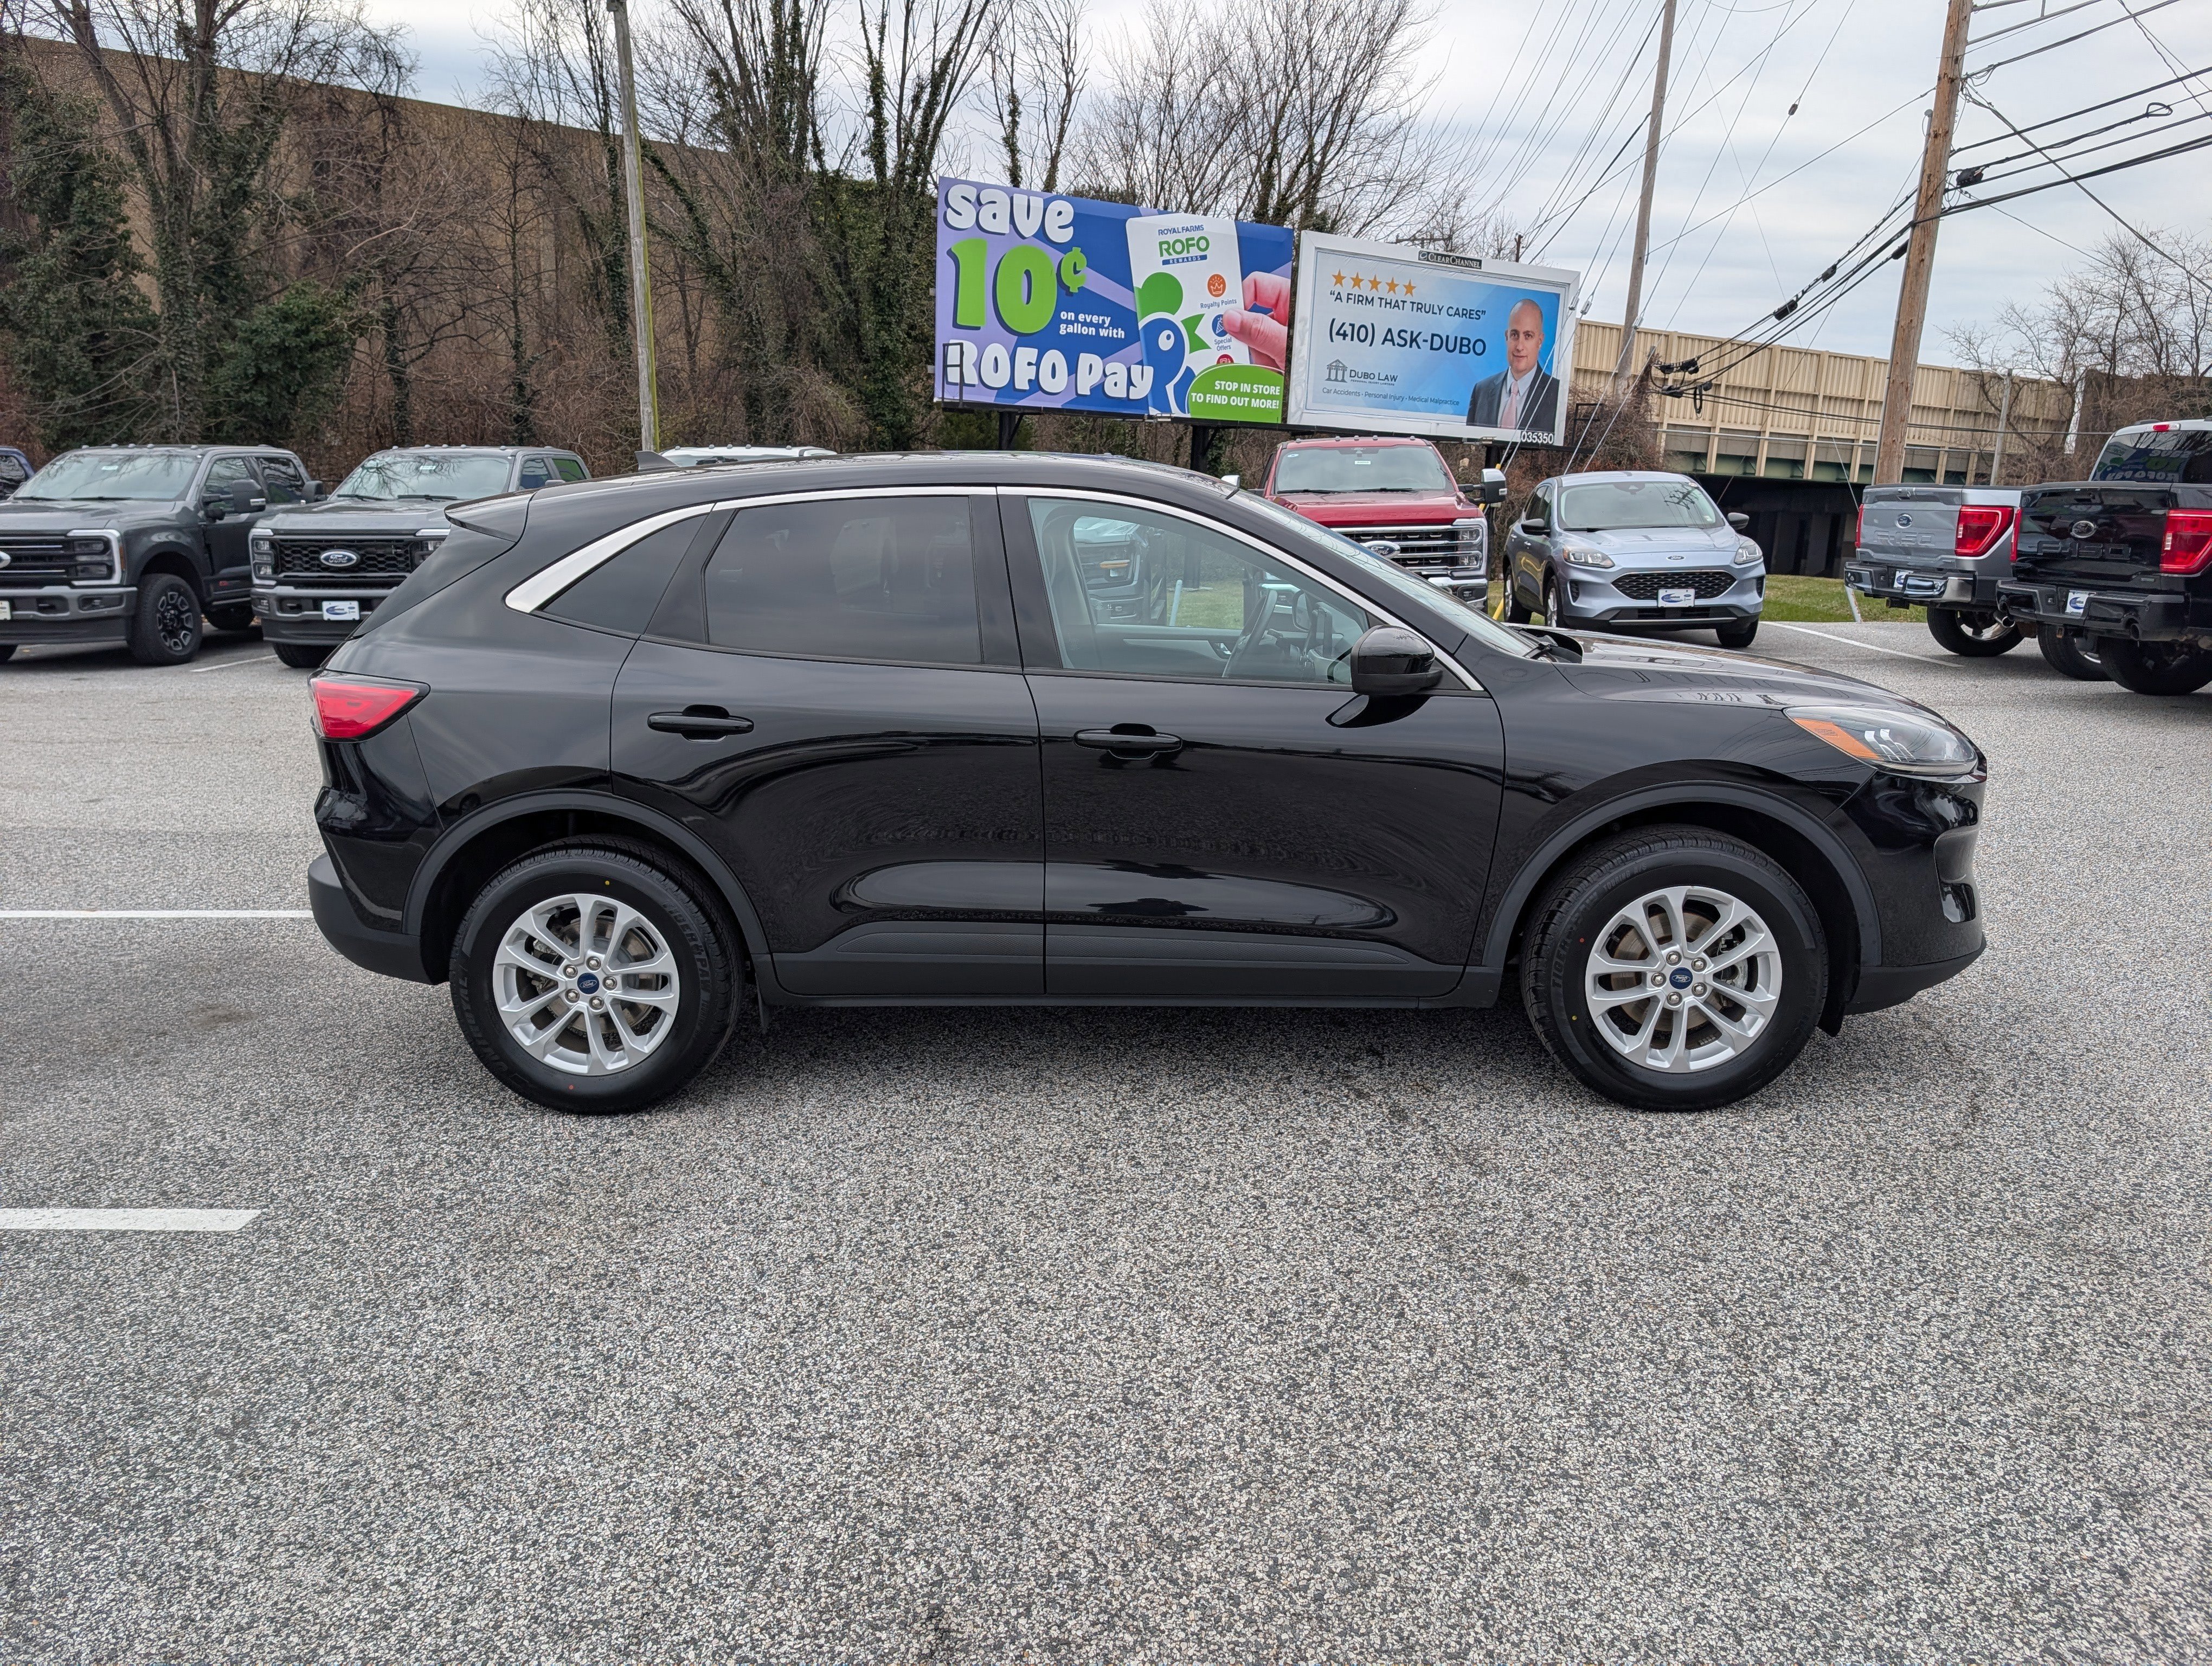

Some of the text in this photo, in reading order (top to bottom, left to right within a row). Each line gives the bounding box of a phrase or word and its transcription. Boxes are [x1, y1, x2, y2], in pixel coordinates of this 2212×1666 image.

[944, 184, 1074, 244] save
[1159, 236, 1210, 257] ROFO
[1169, 255, 1201, 264] REWARDS
[1346, 293, 1374, 306] FIRM
[1378, 297, 1407, 311] THAT
[1410, 301, 1444, 316] TRULY
[1060, 311, 1111, 327] on every
[1059, 323, 1125, 338] gallon with
[1329, 317, 1486, 356] (410) ASK-DUBO
[1214, 337, 1232, 345] Special
[947, 339, 1154, 399] ROFO Pay
[1349, 369, 1398, 382] DUBO LAW
[1214, 380, 1280, 395] STOP IN STORE
[1333, 388, 1360, 396] Accidents
[1364, 392, 1387, 400] Personal
[1388, 394, 1404, 402] Injury
[1191, 393, 1279, 409] TO FIND OUT MORE!
[1521, 431, 1554, 444] 035350
